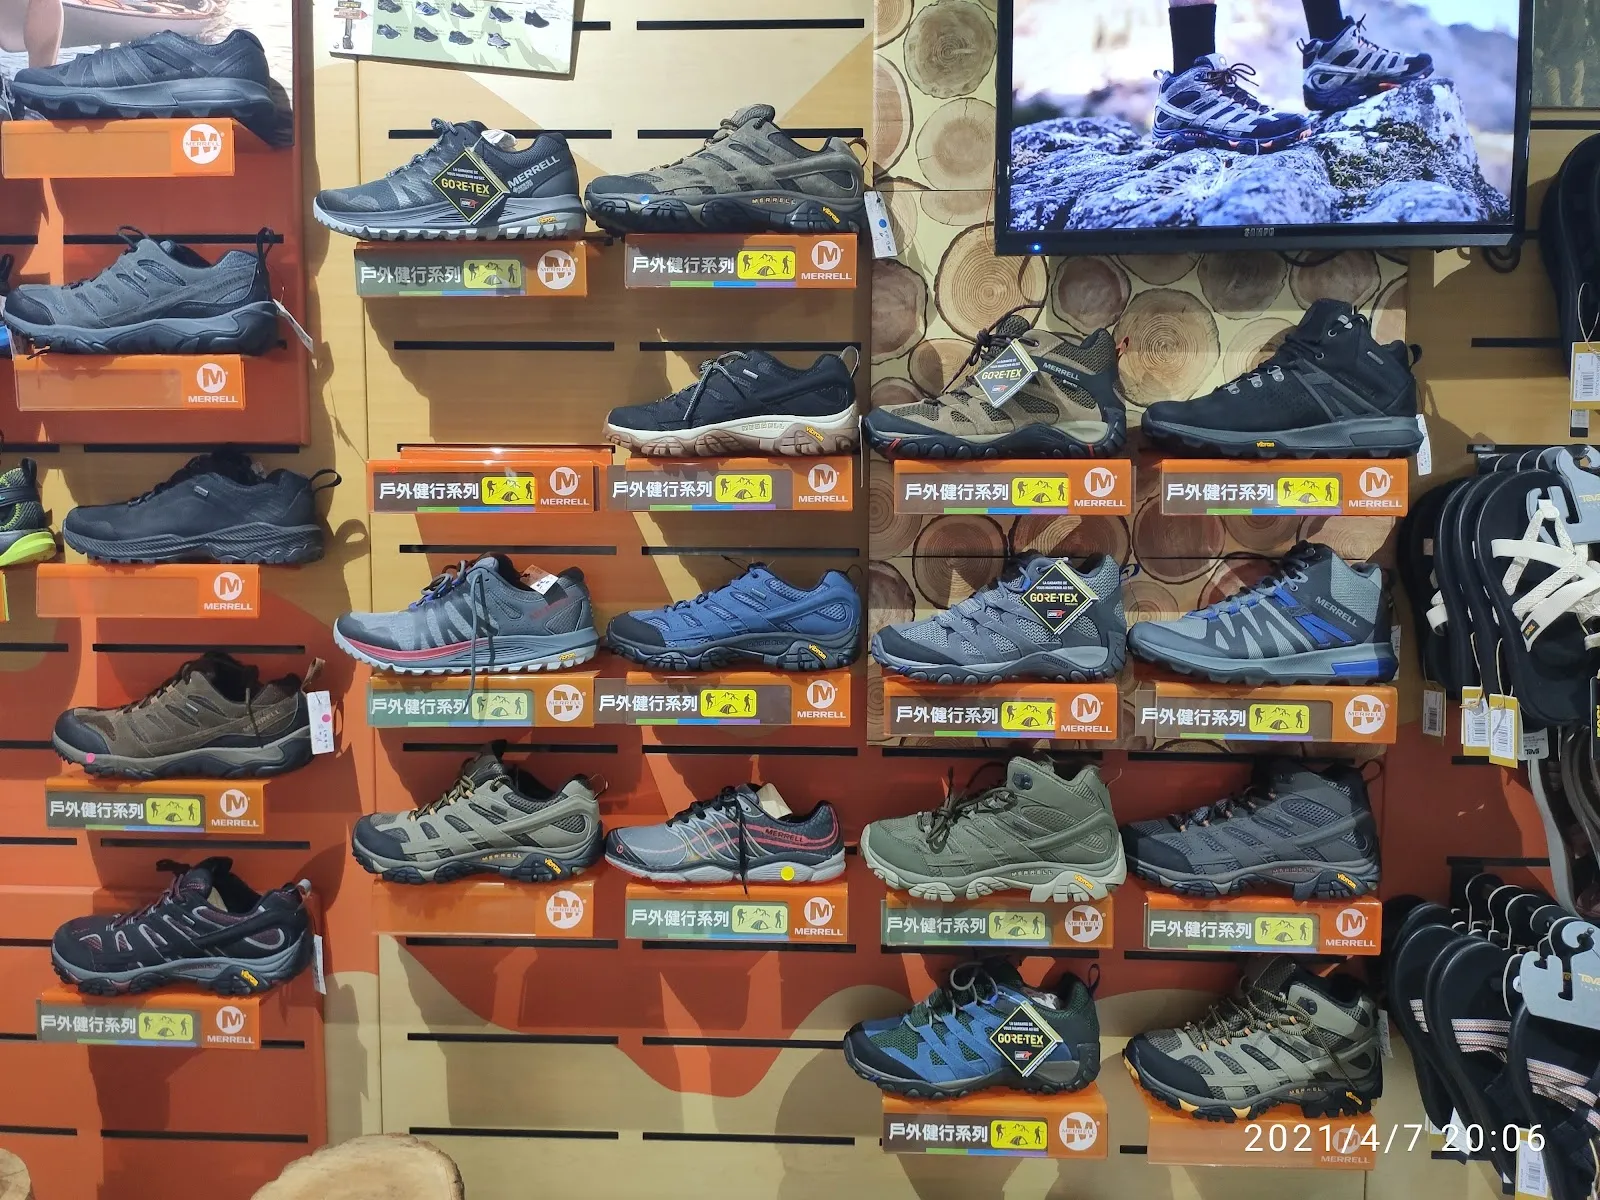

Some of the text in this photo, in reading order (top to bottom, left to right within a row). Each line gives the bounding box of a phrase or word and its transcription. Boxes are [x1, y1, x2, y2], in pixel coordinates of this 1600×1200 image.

[507, 156, 560, 189] MERRELL
[441, 178, 490, 195] GORE-TEX
[752, 197, 797, 205] MERRELL
[632, 256, 734, 274] 戶外健行系列
[360, 266, 461, 284] 戶外健行系列
[801, 271, 852, 281] MERRELL
[981, 368, 1022, 380] GORE-TEX
[1042, 361, 1080, 381] MERRELL
[188, 395, 238, 403] MERRELL
[379, 481, 480, 500] 戶外健行系列
[612, 480, 712, 499] 戶外健行系列
[905, 482, 1009, 501] 戶外健行系列
[1166, 482, 1275, 501] 戶外健行系列
[540, 497, 590, 506] MERRELL
[798, 494, 848, 503] MERRELL
[1074, 499, 1126, 507] MERRELL
[1348, 499, 1402, 508] MERRELL
[1029, 593, 1078, 603] GORE-TEX
[203, 602, 253, 611] MERRELL
[1315, 595, 1359, 628] MERRELL
[598, 695, 698, 712] 戶外健行系列
[796, 710, 846, 719] MERRELL
[896, 706, 998, 725] 戶外健行系列
[1141, 707, 1247, 728] 戶外健行系列
[1060, 725, 1112, 733] MERRELL
[50, 800, 144, 820] 戶外健行系列
[211, 819, 259, 828] MERRELL
[765, 828, 805, 843] MERRELL
[1011, 869, 1053, 877] MERRELL
[631, 909, 730, 928] 戶外健行系列
[794, 928, 843, 936] MERRELL
[1150, 920, 1252, 940] 戶外健行系列
[1325, 939, 1376, 947] MERRELL
[41, 1015, 136, 1034] 戶外健行系列
[207, 1035, 255, 1044] MERRELL
[997, 1033, 1044, 1045] GORE-TEX
[889, 1122, 988, 1143] 戶外健行系列
[1320, 1155, 1370, 1164] MERRELL
